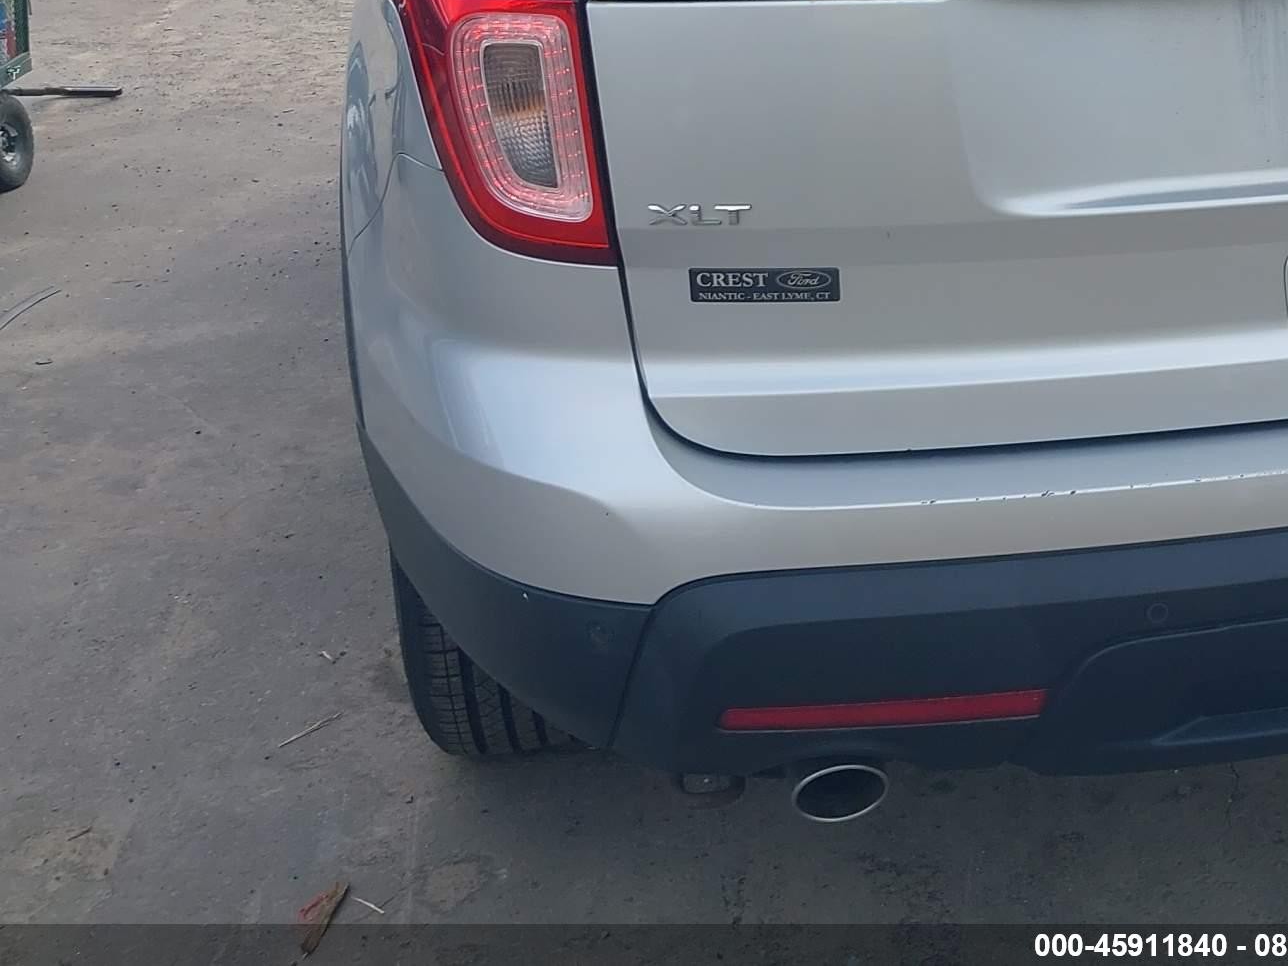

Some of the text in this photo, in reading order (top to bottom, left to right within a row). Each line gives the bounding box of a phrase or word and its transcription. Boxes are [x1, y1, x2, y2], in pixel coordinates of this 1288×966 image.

[646, 203, 753, 226] XLT
[696, 272, 769, 287] CREST
[699, 292, 745, 300] NIANTIC
[753, 292, 780, 300] EAST
[816, 292, 831, 300] CT
